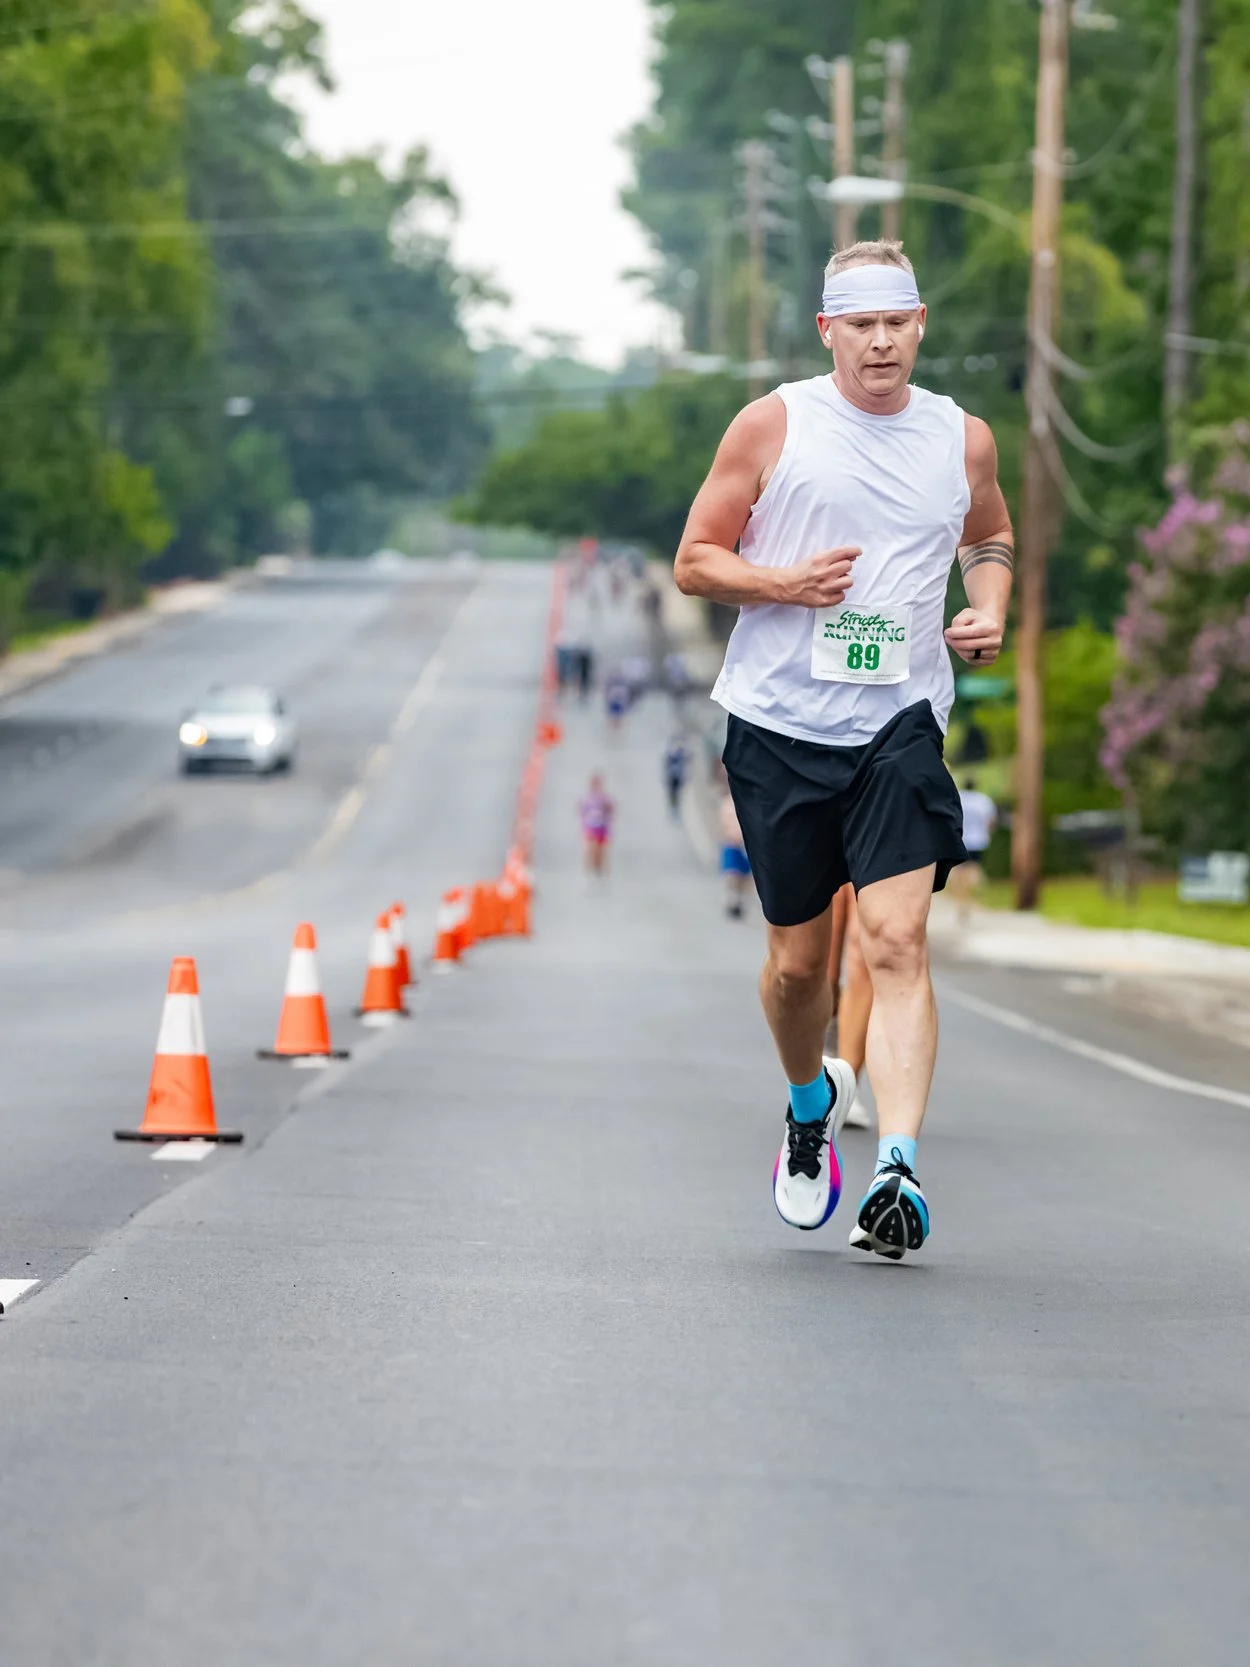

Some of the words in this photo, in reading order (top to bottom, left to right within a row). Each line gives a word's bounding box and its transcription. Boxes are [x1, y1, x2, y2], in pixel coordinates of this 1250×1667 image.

[840, 610, 894, 631] Strictly
[824, 623, 905, 642] RUNNING
[847, 643, 880, 670] 89
